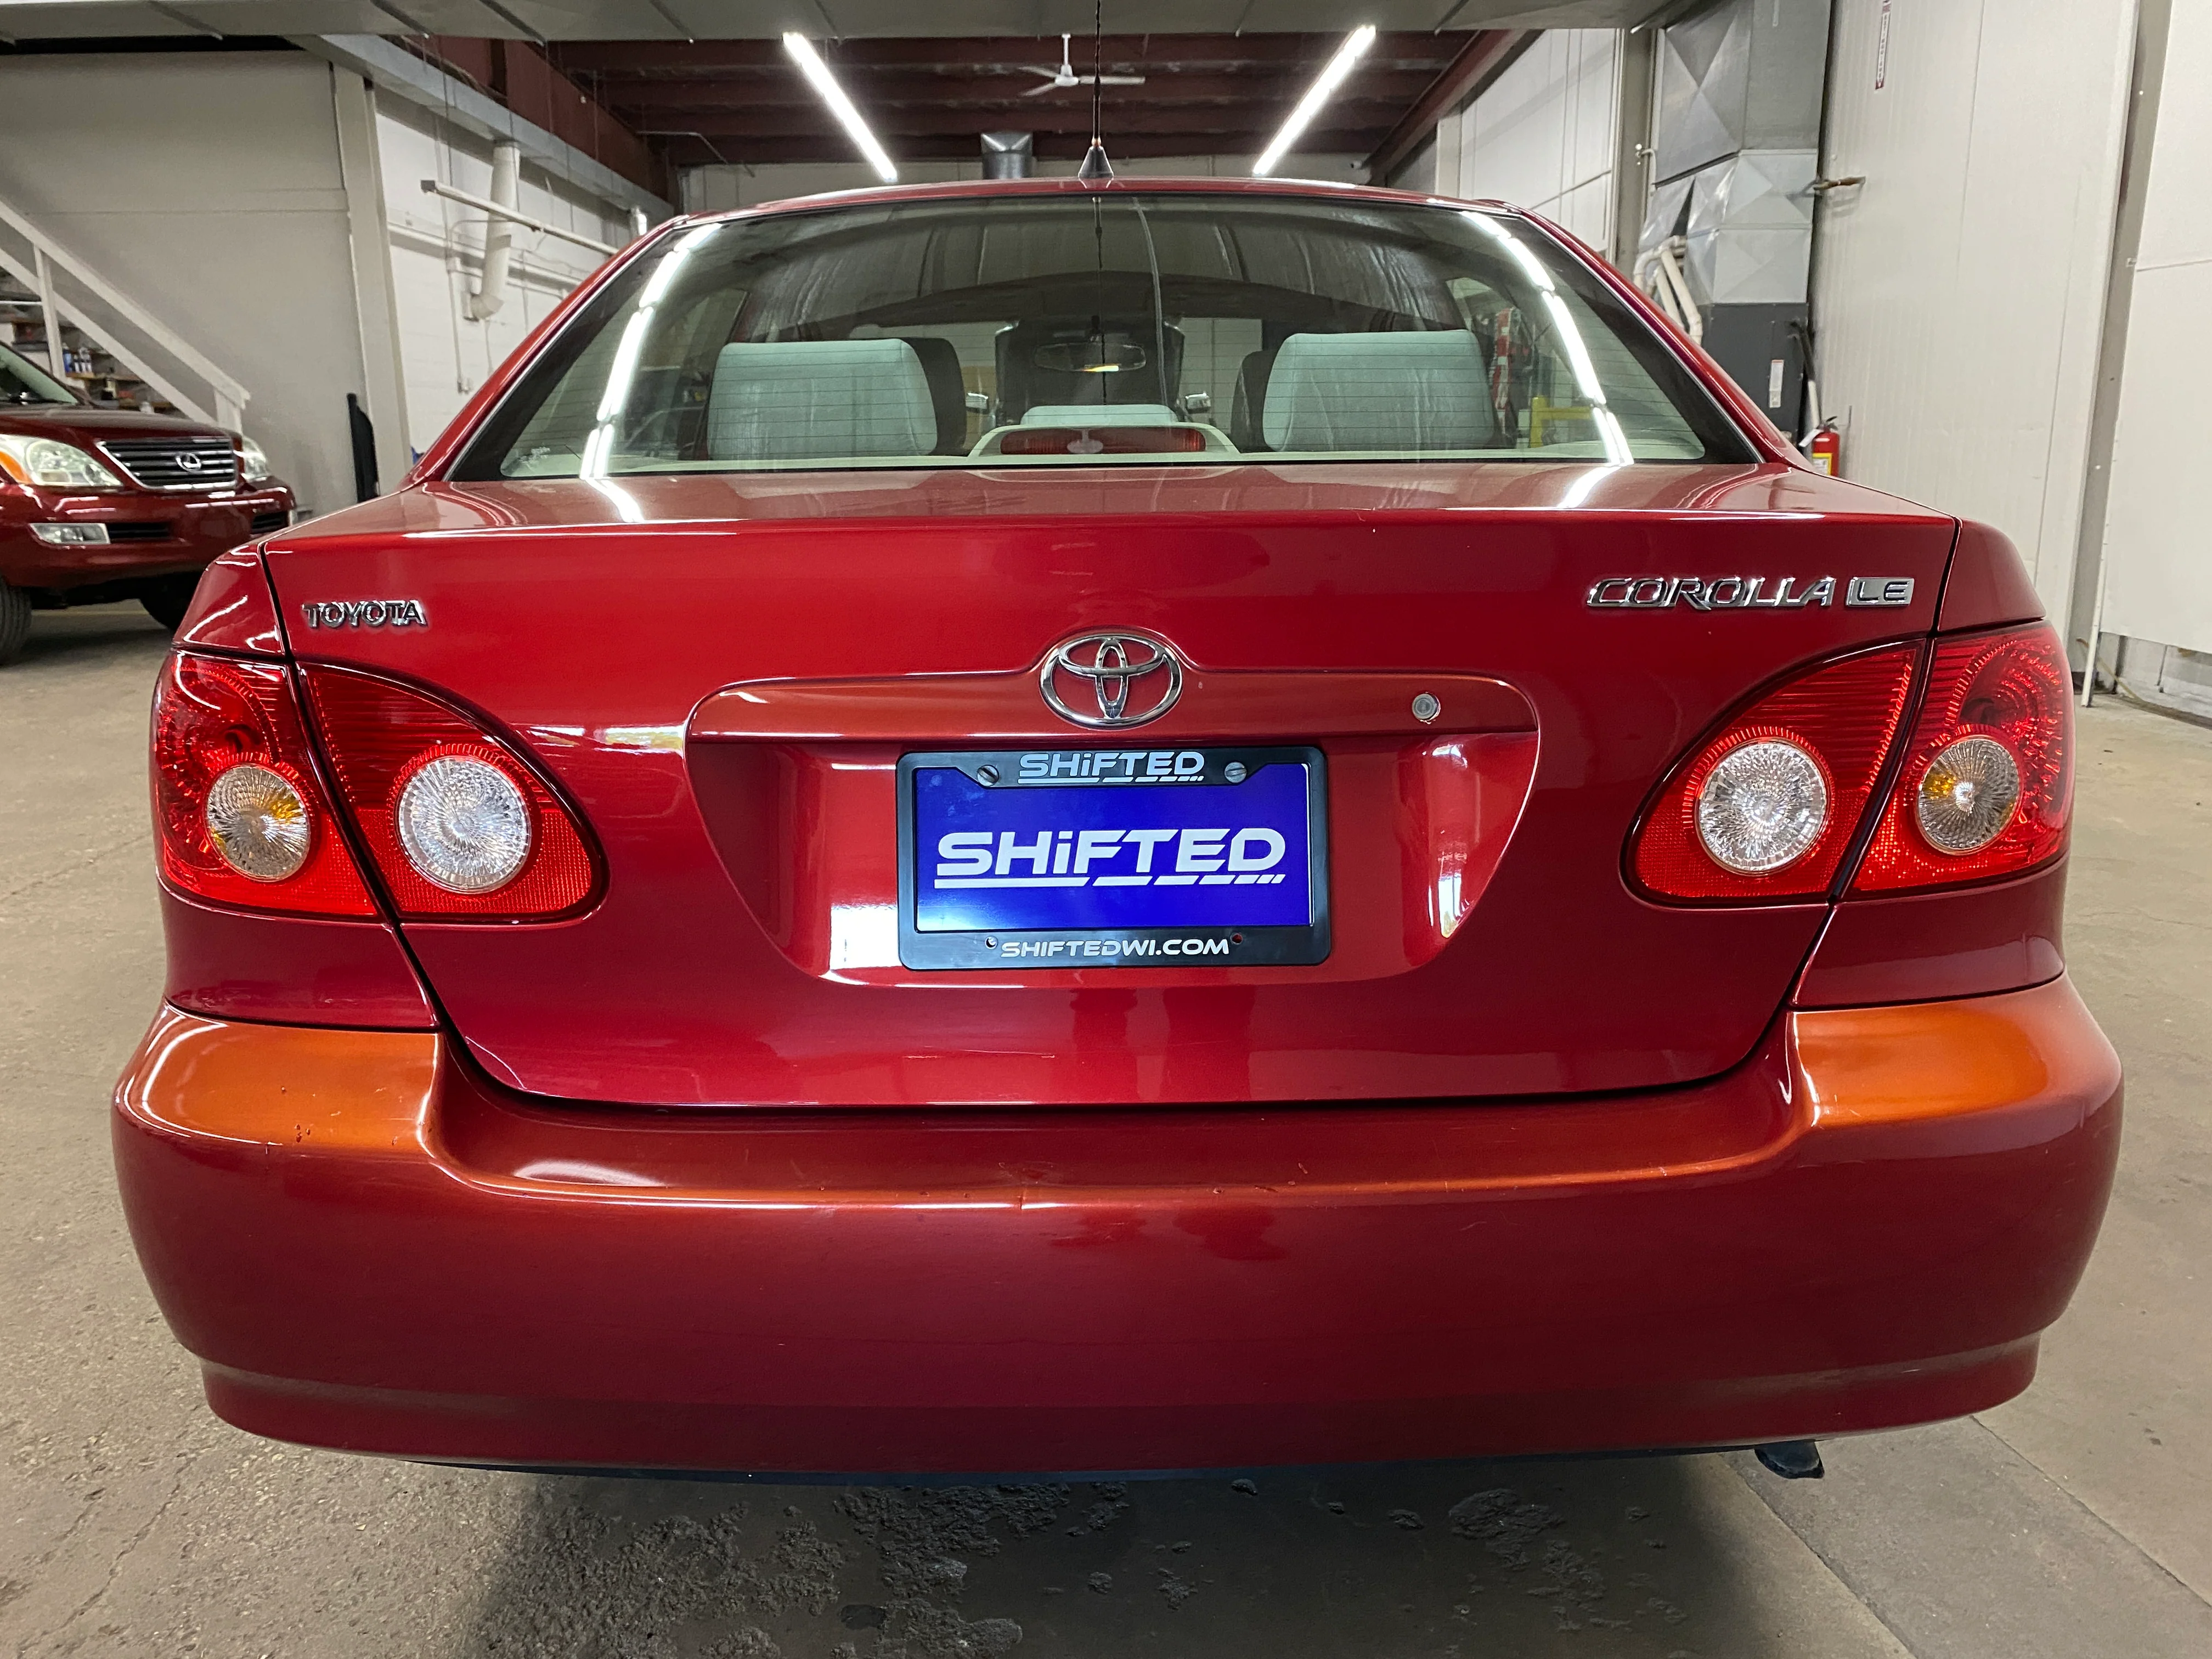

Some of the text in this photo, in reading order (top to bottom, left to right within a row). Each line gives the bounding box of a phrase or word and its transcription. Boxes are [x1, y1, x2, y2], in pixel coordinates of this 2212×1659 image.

[1587, 577, 1911, 610] COROLLA LE
[302, 600, 428, 627] TOYOTA
[1000, 939, 1229, 958] SHIFTEDWI.COM
